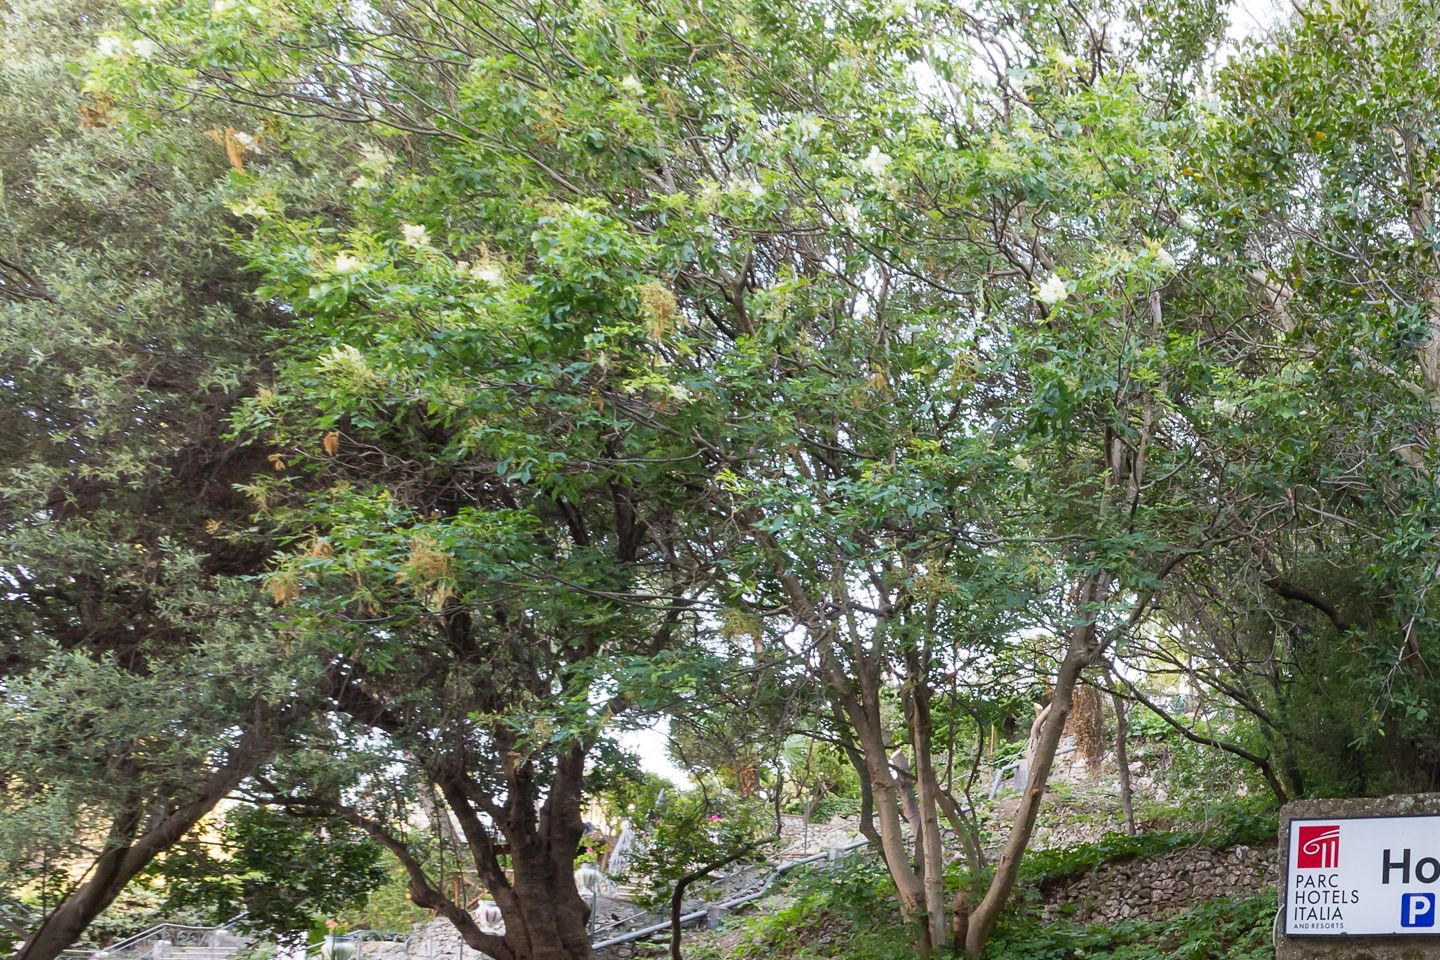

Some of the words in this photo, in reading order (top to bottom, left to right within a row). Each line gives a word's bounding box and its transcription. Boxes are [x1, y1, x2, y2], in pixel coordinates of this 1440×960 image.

[1296, 874, 1338, 888] PARC
[1295, 890, 1359, 904] HOTELS
[1294, 907, 1343, 920] ITALIA
